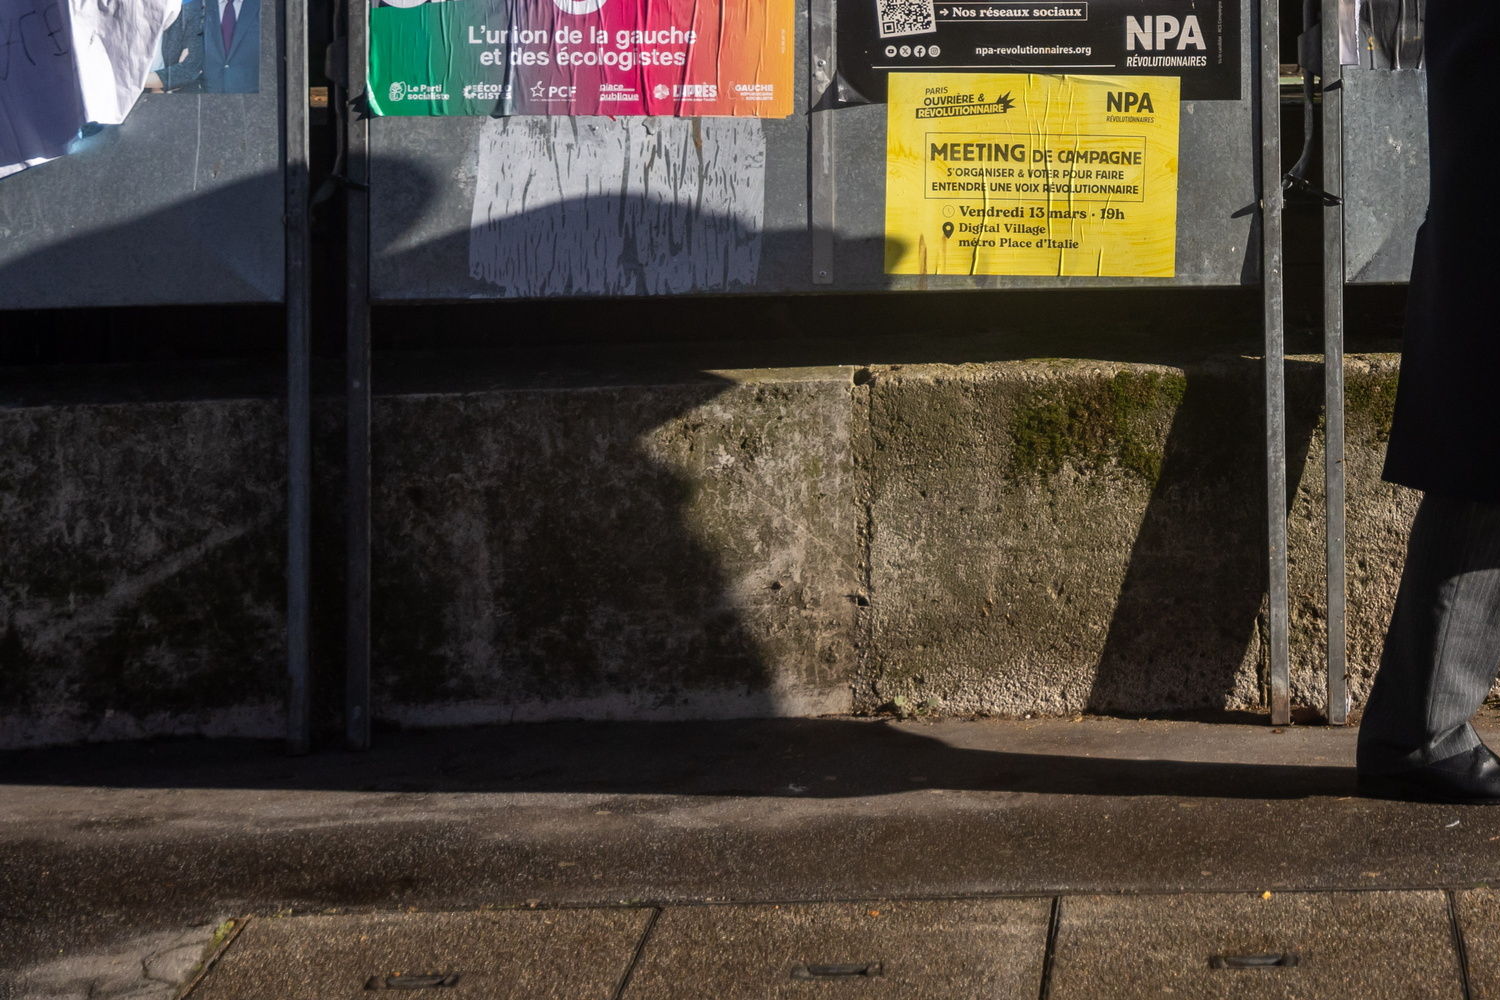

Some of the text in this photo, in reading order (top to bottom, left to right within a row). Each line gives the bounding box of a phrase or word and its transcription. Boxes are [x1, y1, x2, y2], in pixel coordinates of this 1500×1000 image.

[952, 6, 1082, 17] Nos réseaux sociaux
[555, 26, 583, 44] de
[590, 26, 608, 44] la
[616, 25, 697, 49] gauche
[1126, 15, 1206, 51] NPA
[975, 45, 1092, 57] npa-revolutionnaires.org
[480, 46, 686, 71] et des écologistes
[1126, 54, 1206, 68] RÉVOLUTIONNAIRES
[549, 85, 577, 98] PCF
[925, 87, 948, 95] PARIS
[924, 94, 975, 106] OUVRIÈRE
[1106, 92, 1154, 114] NPA
[918, 103, 1005, 119] RÉVOLUTIONNAIRE
[930, 143, 1142, 165] MEETING DE CAMPAGNE
[1062, 169, 1124, 180] POUR FAIRE
[932, 182, 1039, 192] ENTENDRE UNE VOIX
[959, 206, 1125, 220] Vendredi 13 mars 19h
[959, 223, 1046, 235] Digital Village
[999, 238, 1032, 248] Place
